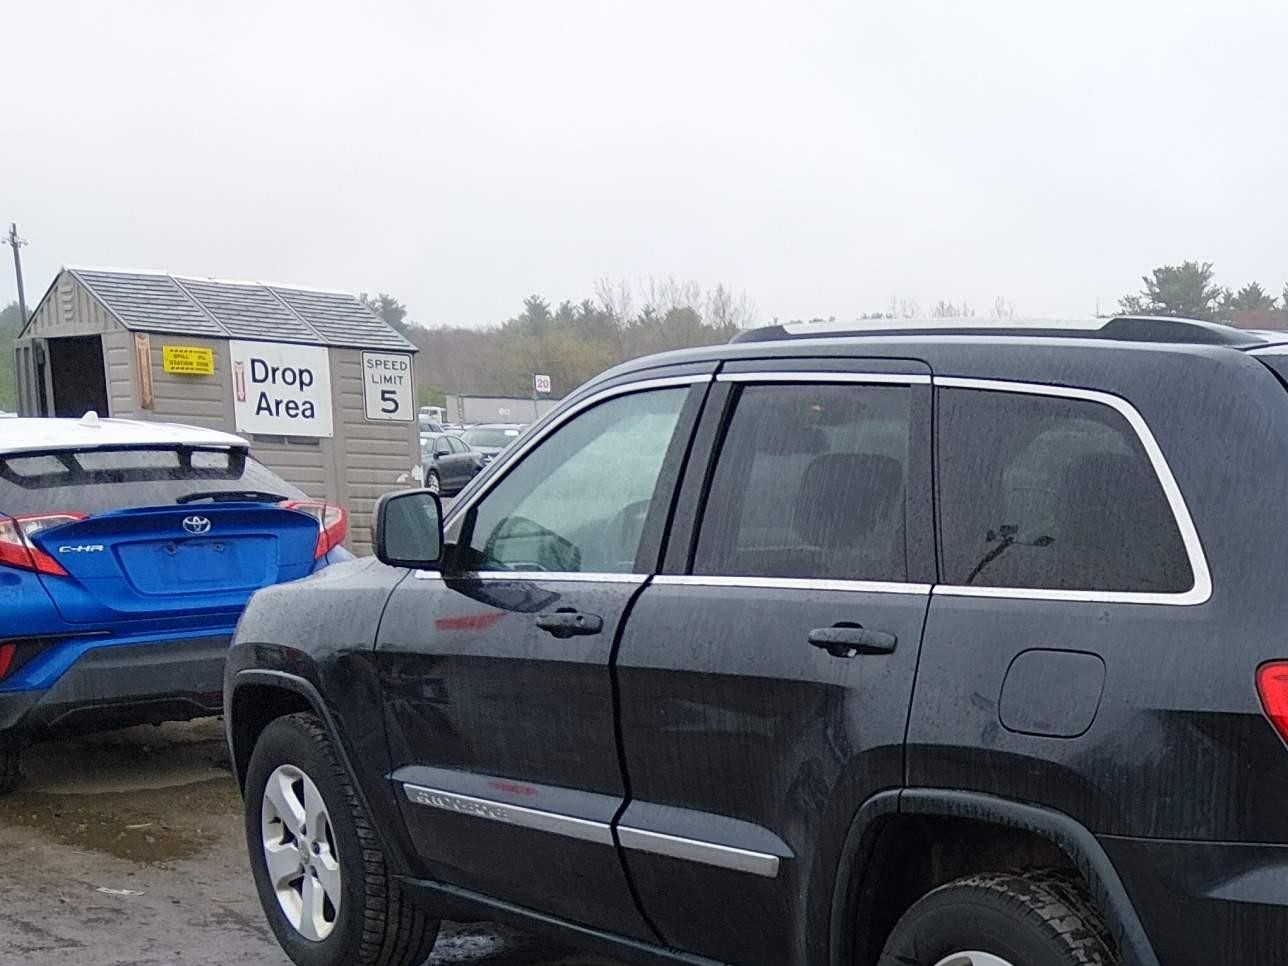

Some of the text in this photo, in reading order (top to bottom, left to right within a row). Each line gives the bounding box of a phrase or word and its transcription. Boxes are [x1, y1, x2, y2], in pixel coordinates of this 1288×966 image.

[366, 359, 408, 372] SPEED
[250, 358, 314, 391] Drop
[371, 374, 404, 386] LIMIT
[537, 378, 548, 388] 20
[255, 391, 315, 419] Area
[380, 389, 399, 414] 5
[58, 544, 104, 553] C-HR
